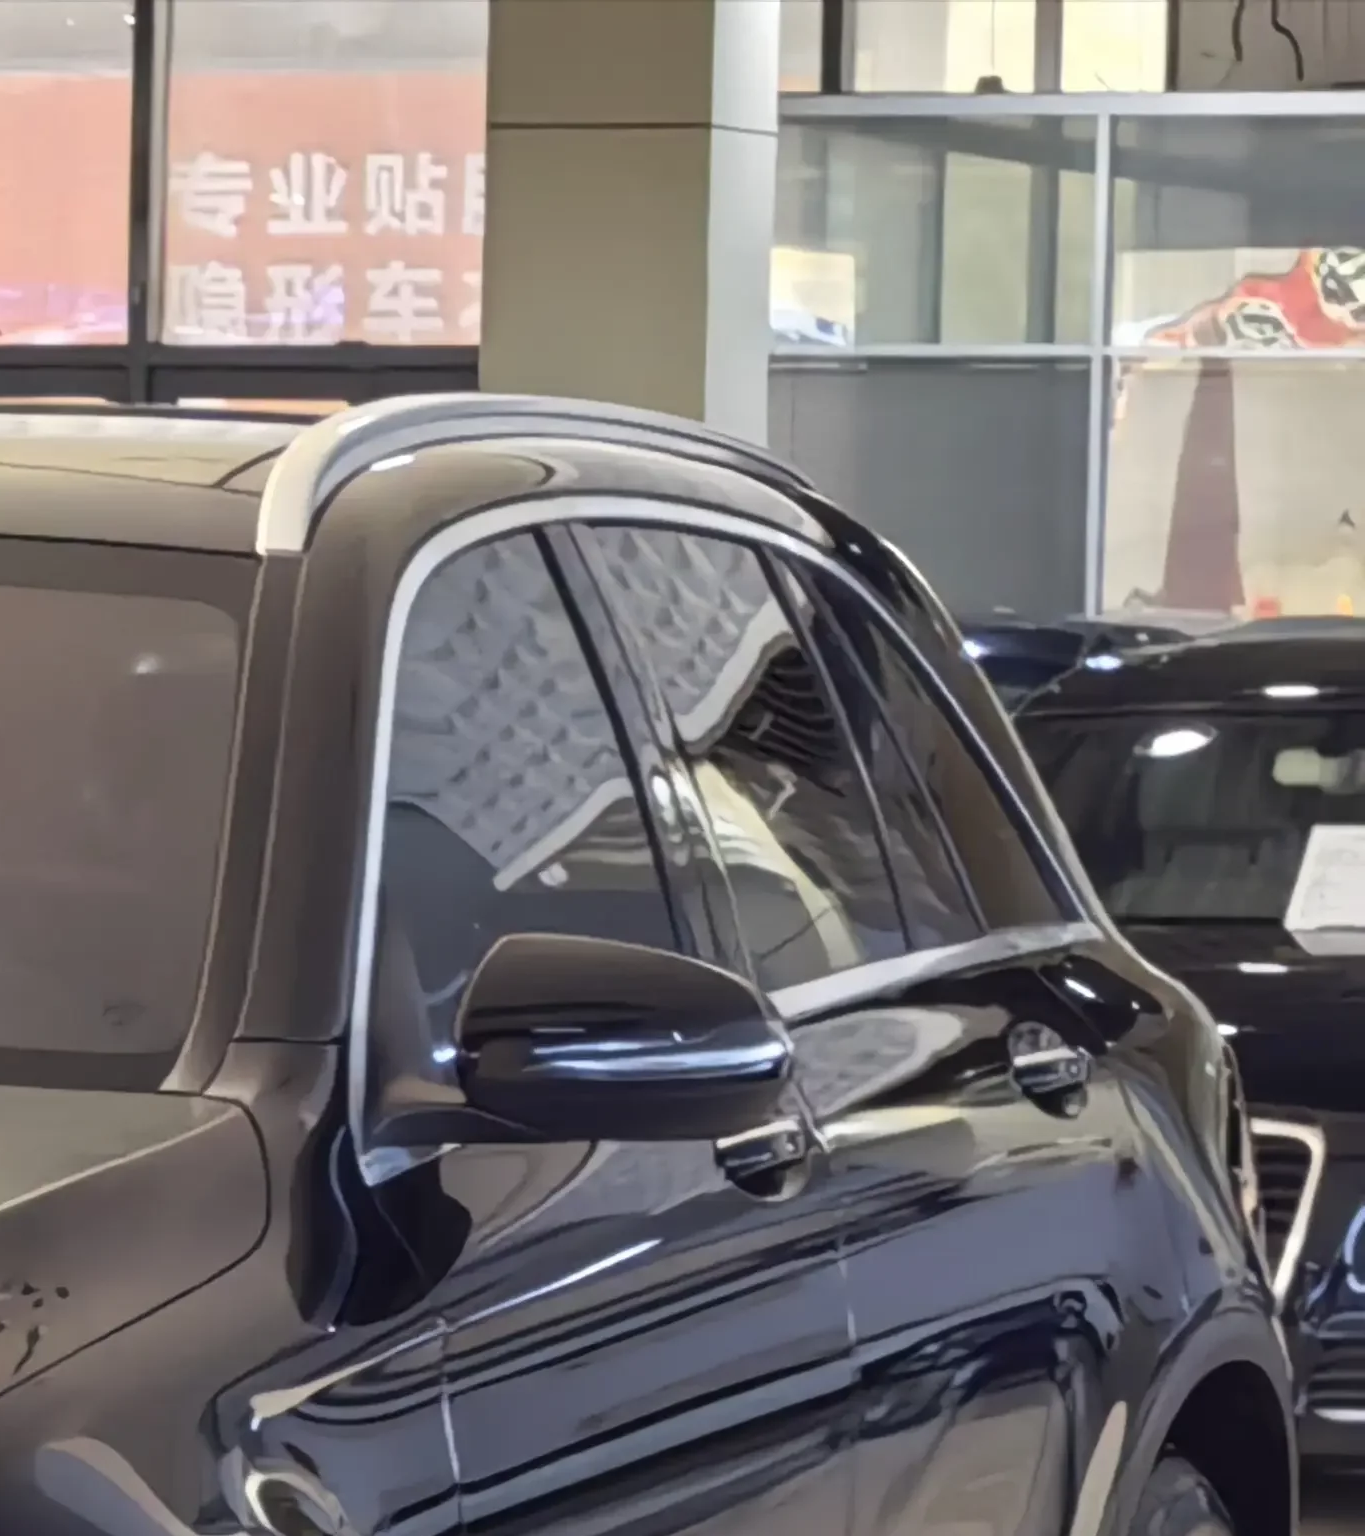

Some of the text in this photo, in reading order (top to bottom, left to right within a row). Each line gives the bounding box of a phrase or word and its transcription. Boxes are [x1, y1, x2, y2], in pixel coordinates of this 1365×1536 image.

[168, 150, 485, 238] 专业贴
[166, 260, 482, 344] 隐形车
